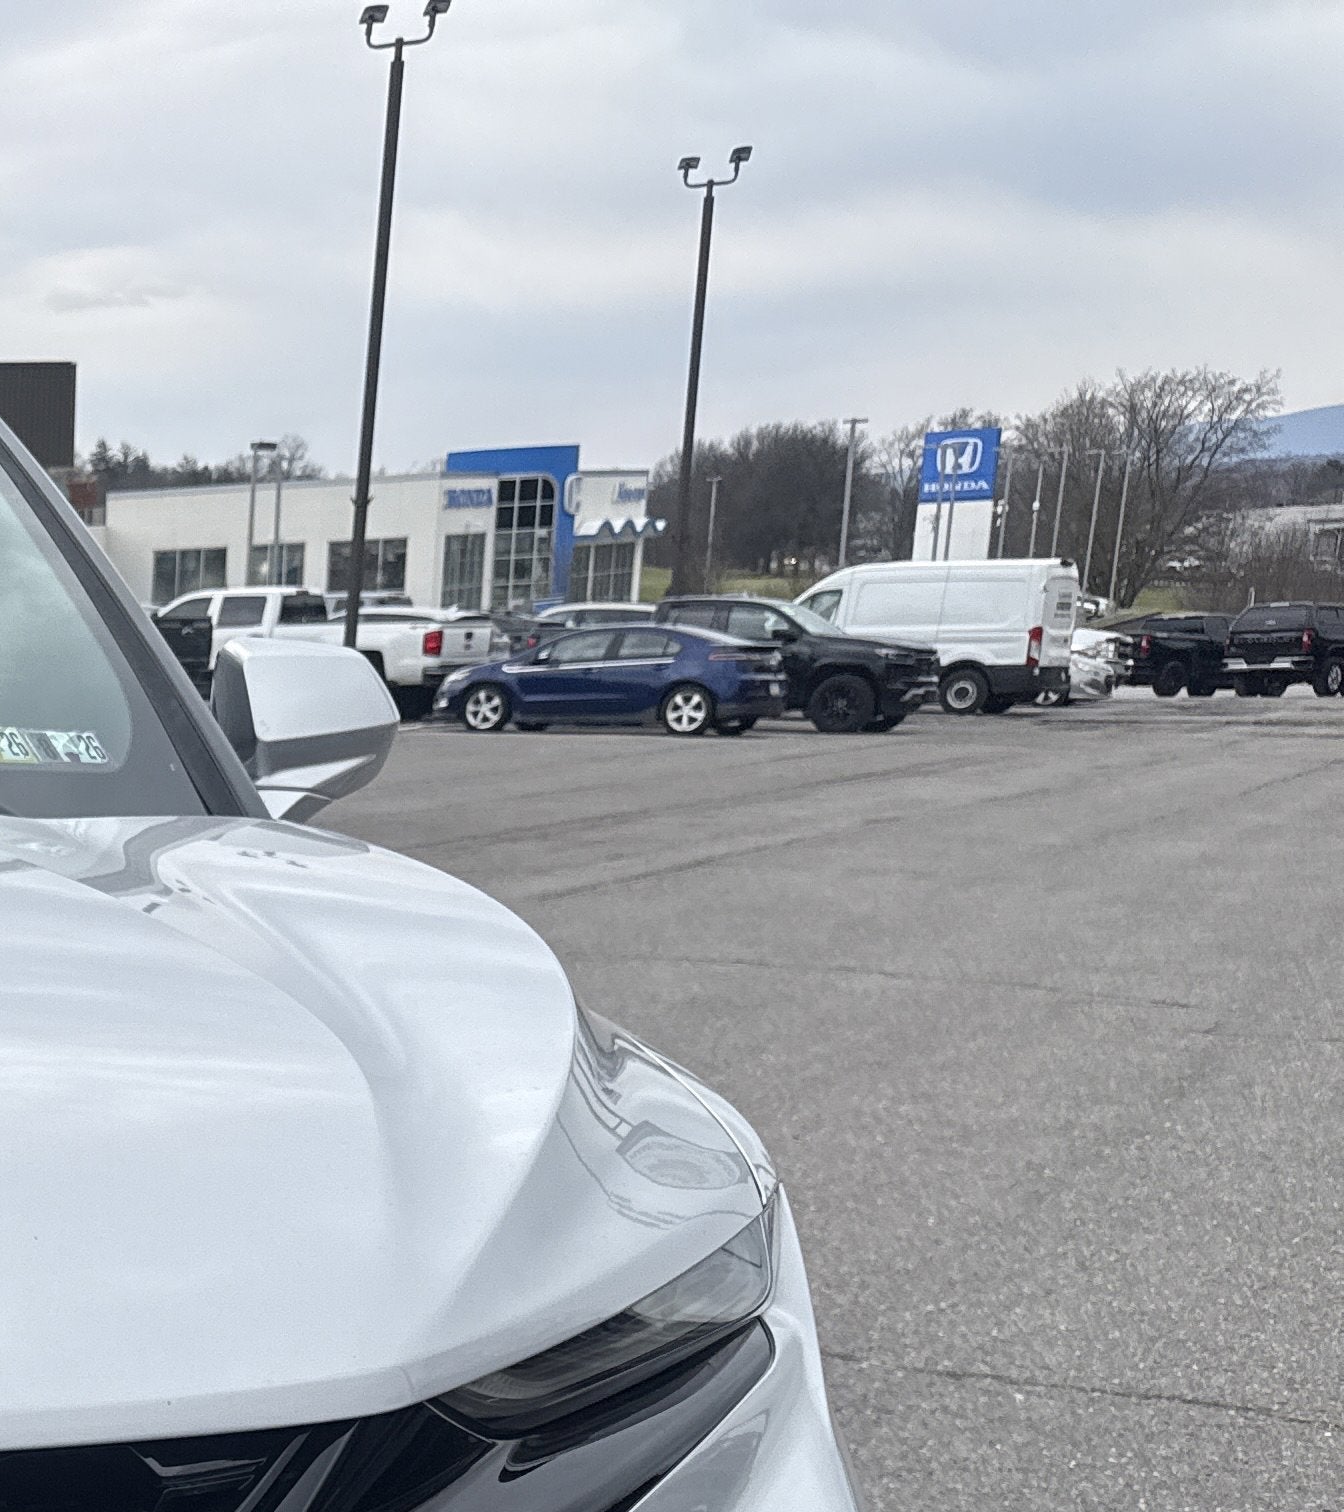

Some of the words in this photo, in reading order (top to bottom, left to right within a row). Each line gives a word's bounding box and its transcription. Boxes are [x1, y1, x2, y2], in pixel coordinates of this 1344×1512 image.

[924, 480, 990, 493] HONDA
[0, 731, 30, 757] 26
[76, 734, 107, 760] 26
